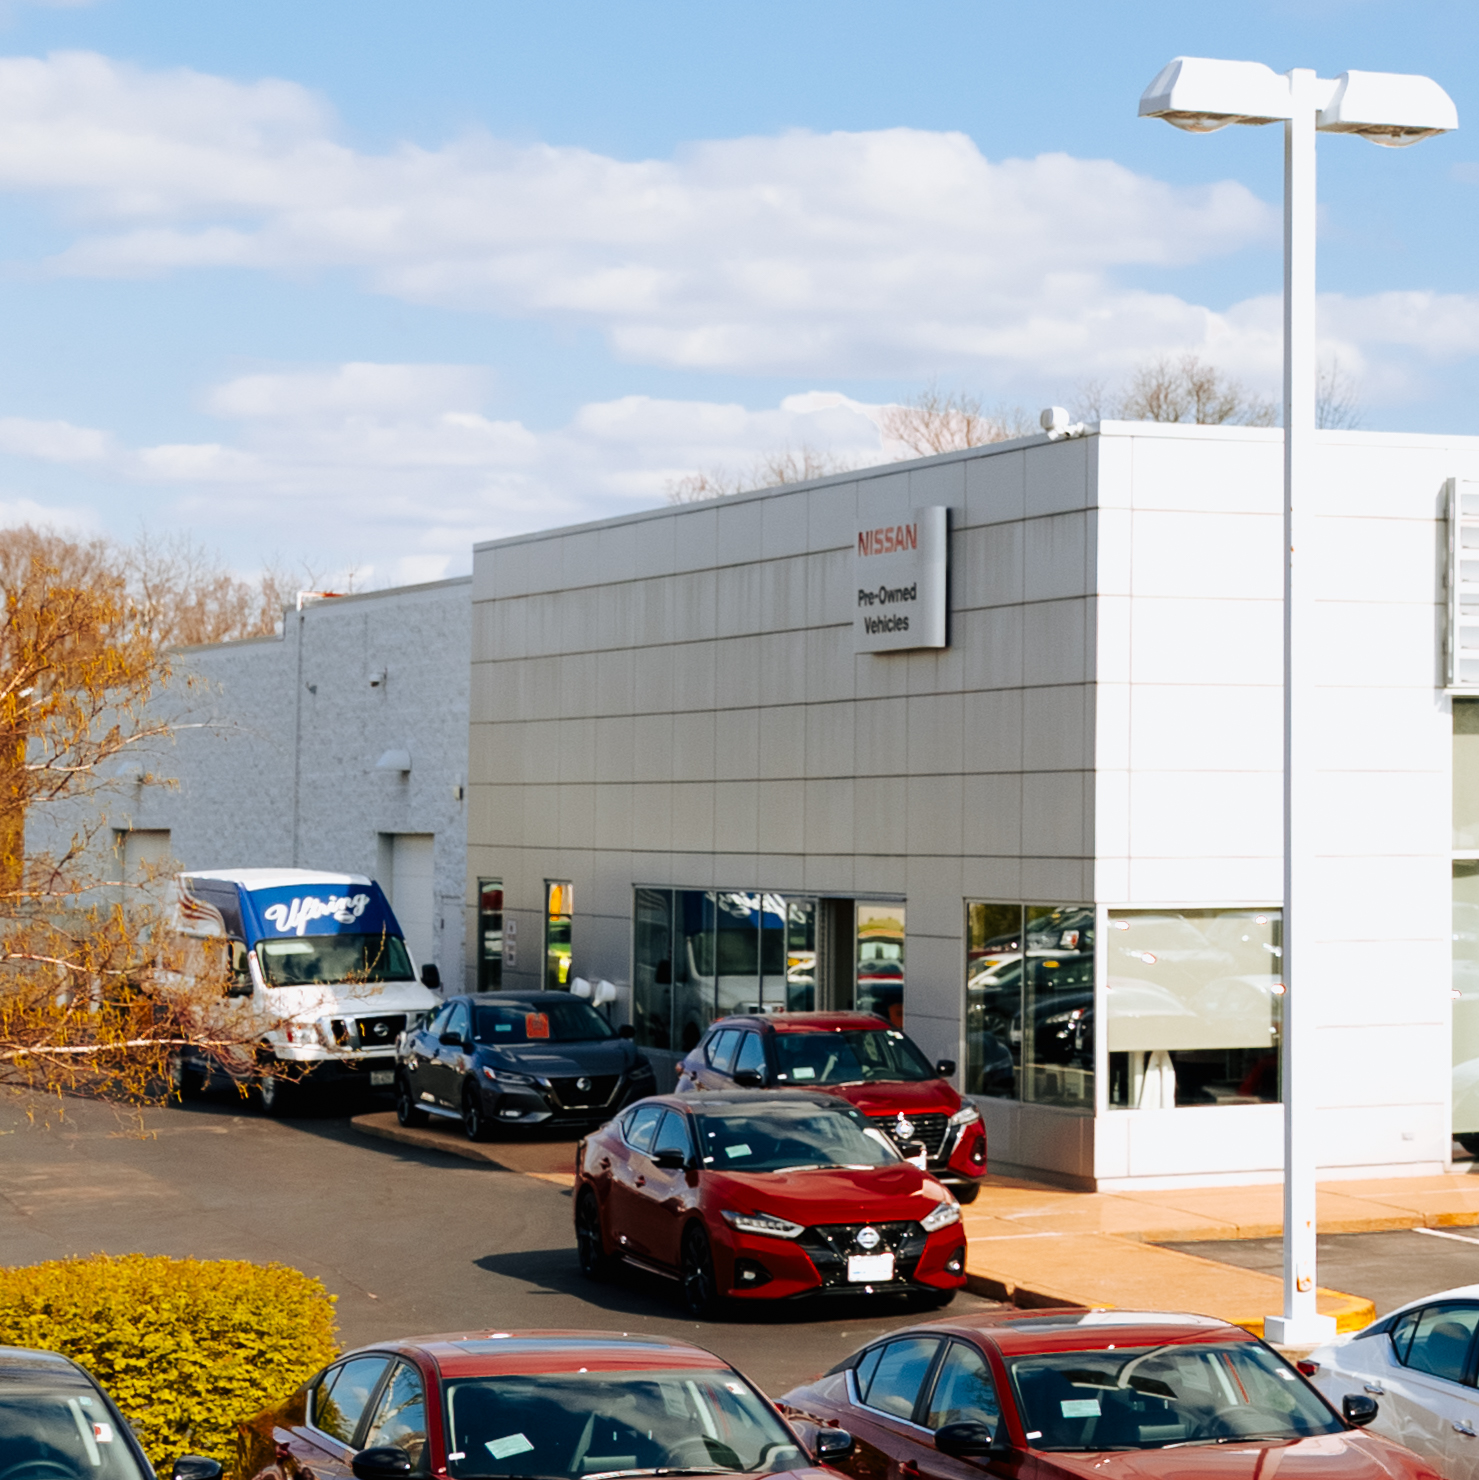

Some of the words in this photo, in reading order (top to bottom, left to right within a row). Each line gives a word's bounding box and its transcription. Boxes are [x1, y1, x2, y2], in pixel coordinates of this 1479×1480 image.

[858, 523, 917, 556] NISSAN
[858, 582, 917, 607] Pre-Owned
[864, 614, 909, 634] Vehicles
